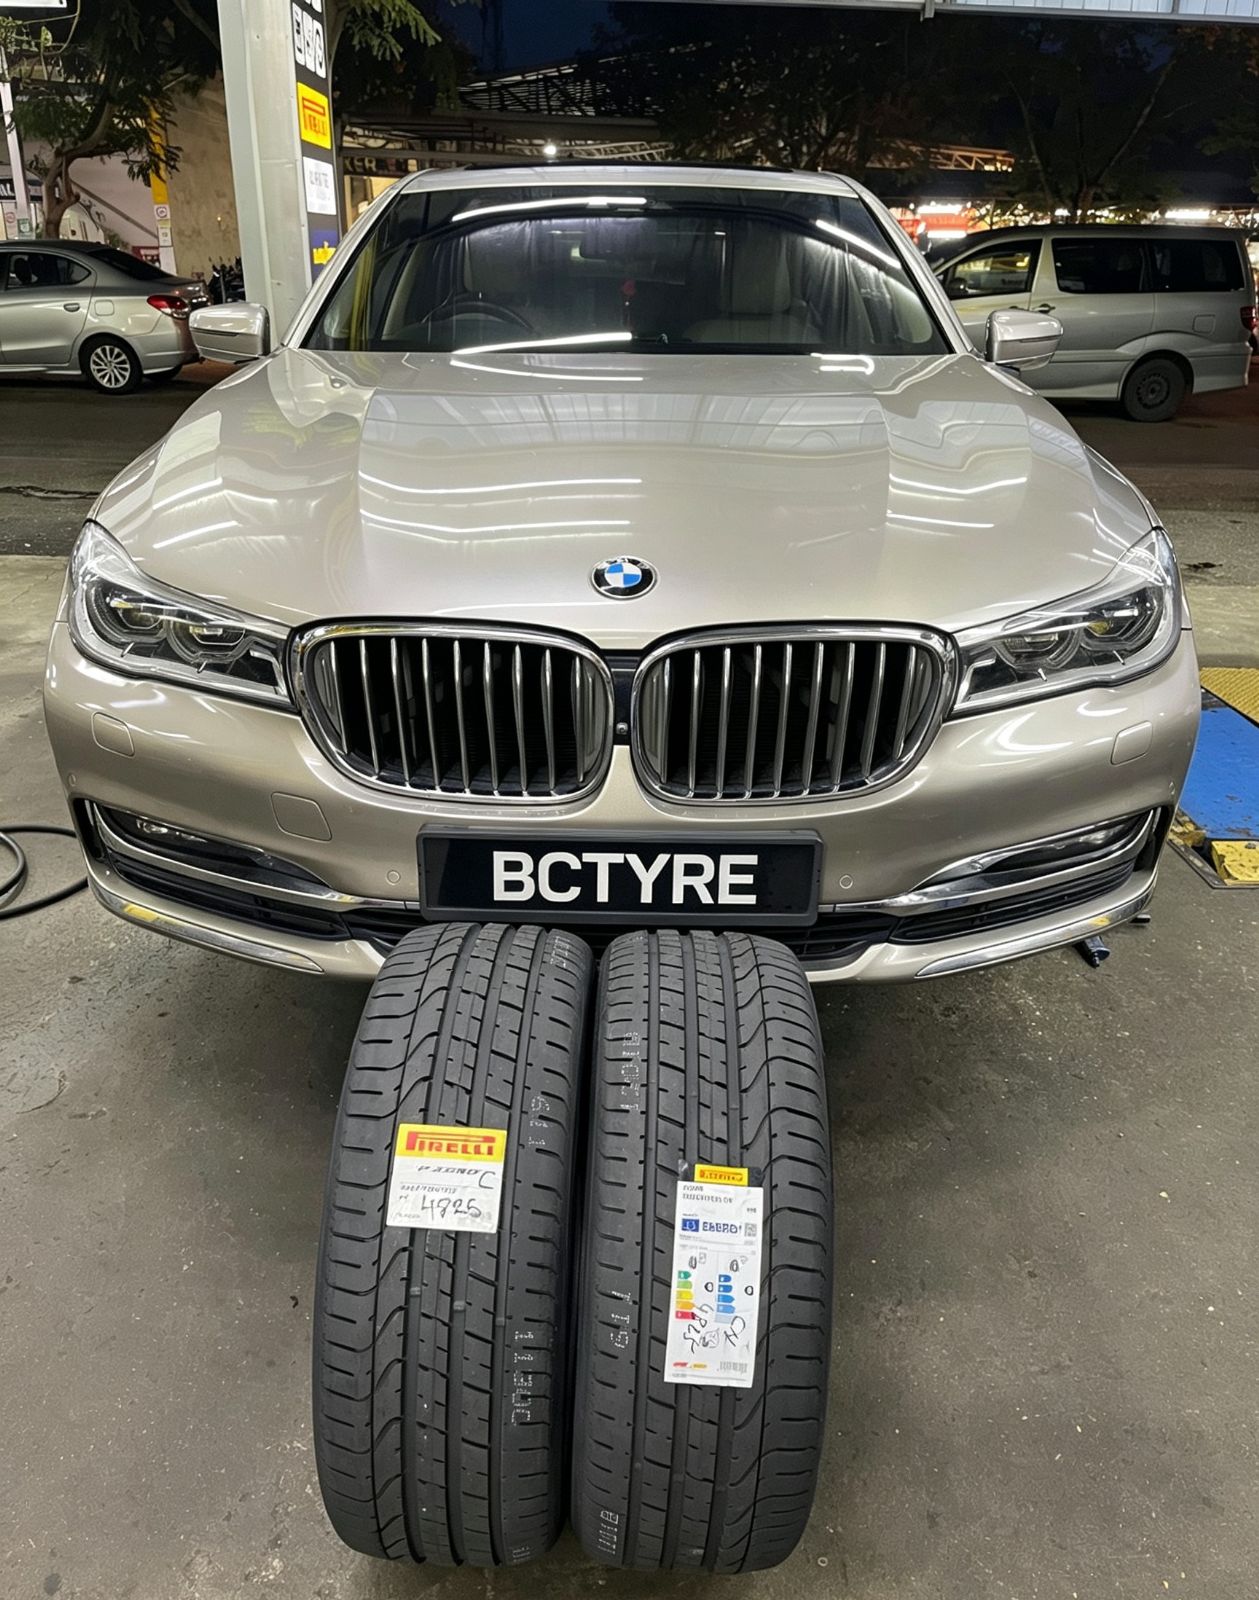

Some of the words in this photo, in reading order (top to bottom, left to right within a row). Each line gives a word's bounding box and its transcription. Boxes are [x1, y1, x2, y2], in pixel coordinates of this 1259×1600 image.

[492, 850, 759, 905] BCTYRE
[405, 1131, 496, 1156] PIRELLI
[478, 1170, 496, 1190] C
